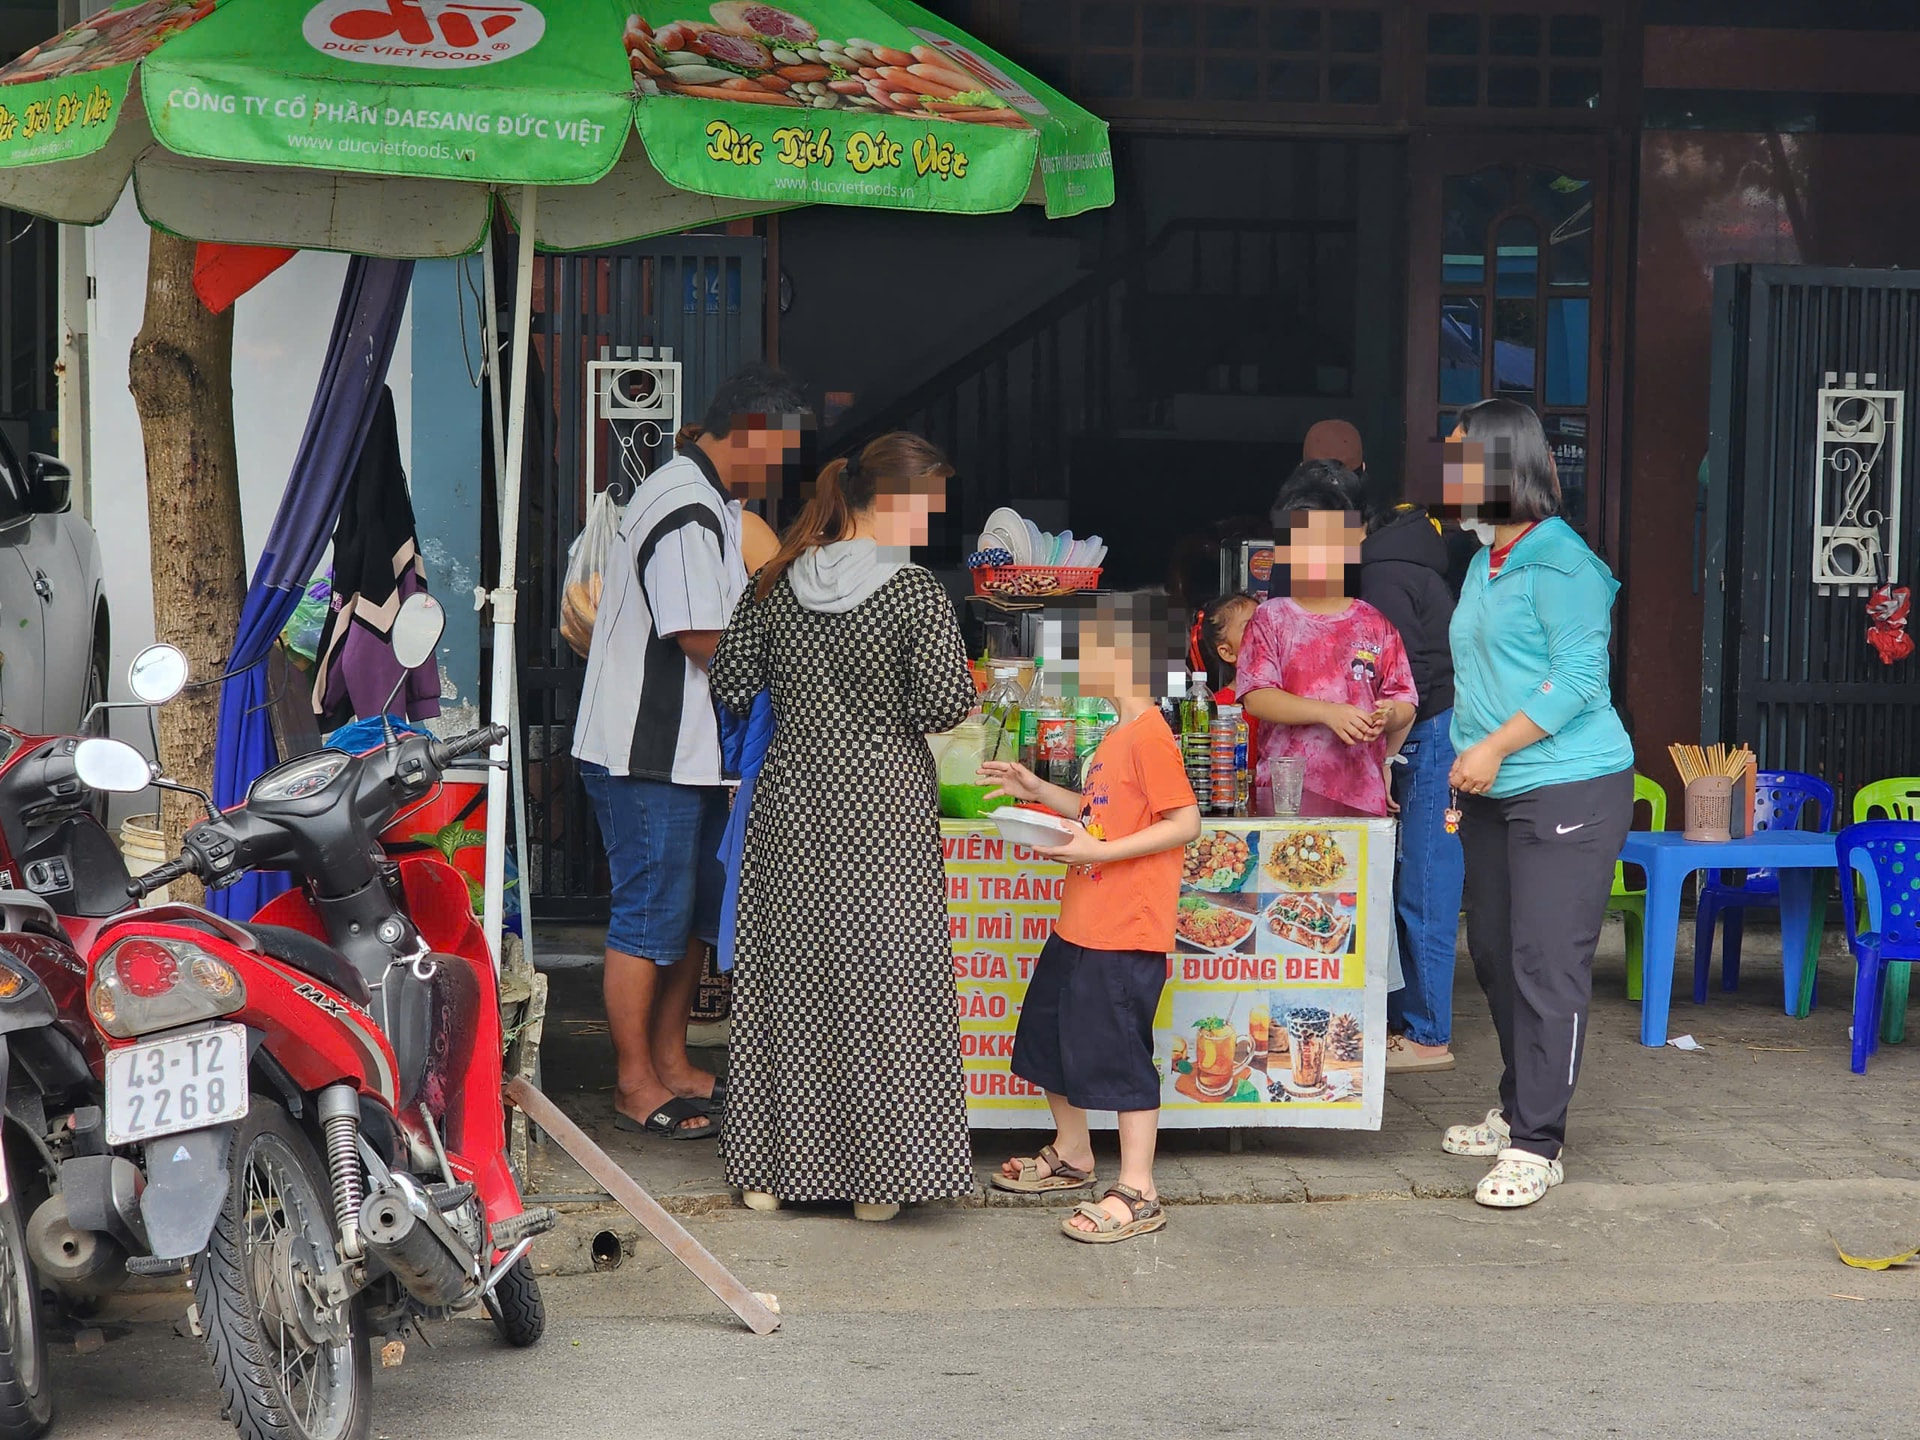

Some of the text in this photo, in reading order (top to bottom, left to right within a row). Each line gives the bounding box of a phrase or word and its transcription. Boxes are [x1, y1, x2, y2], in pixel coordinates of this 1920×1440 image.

[321, 42, 493, 62] DUC VIET FOODS
[168, 87, 606, 149] CÔNG TY CỔ PHẦN DAESANG ĐỨC VIỆT
[846, 130, 903, 174] Đức
[911, 133, 969, 181] Việt
[774, 176, 915, 199] www.ducvietfoods.vn
[977, 912, 1012, 939] MÌ
[953, 951, 1008, 979] SỮA
[1182, 953, 1276, 980] ĐƯỜNG
[1285, 958, 1340, 980] ĐEN
[127, 1035, 224, 1088] 43-T2
[127, 1077, 226, 1133] 2268
